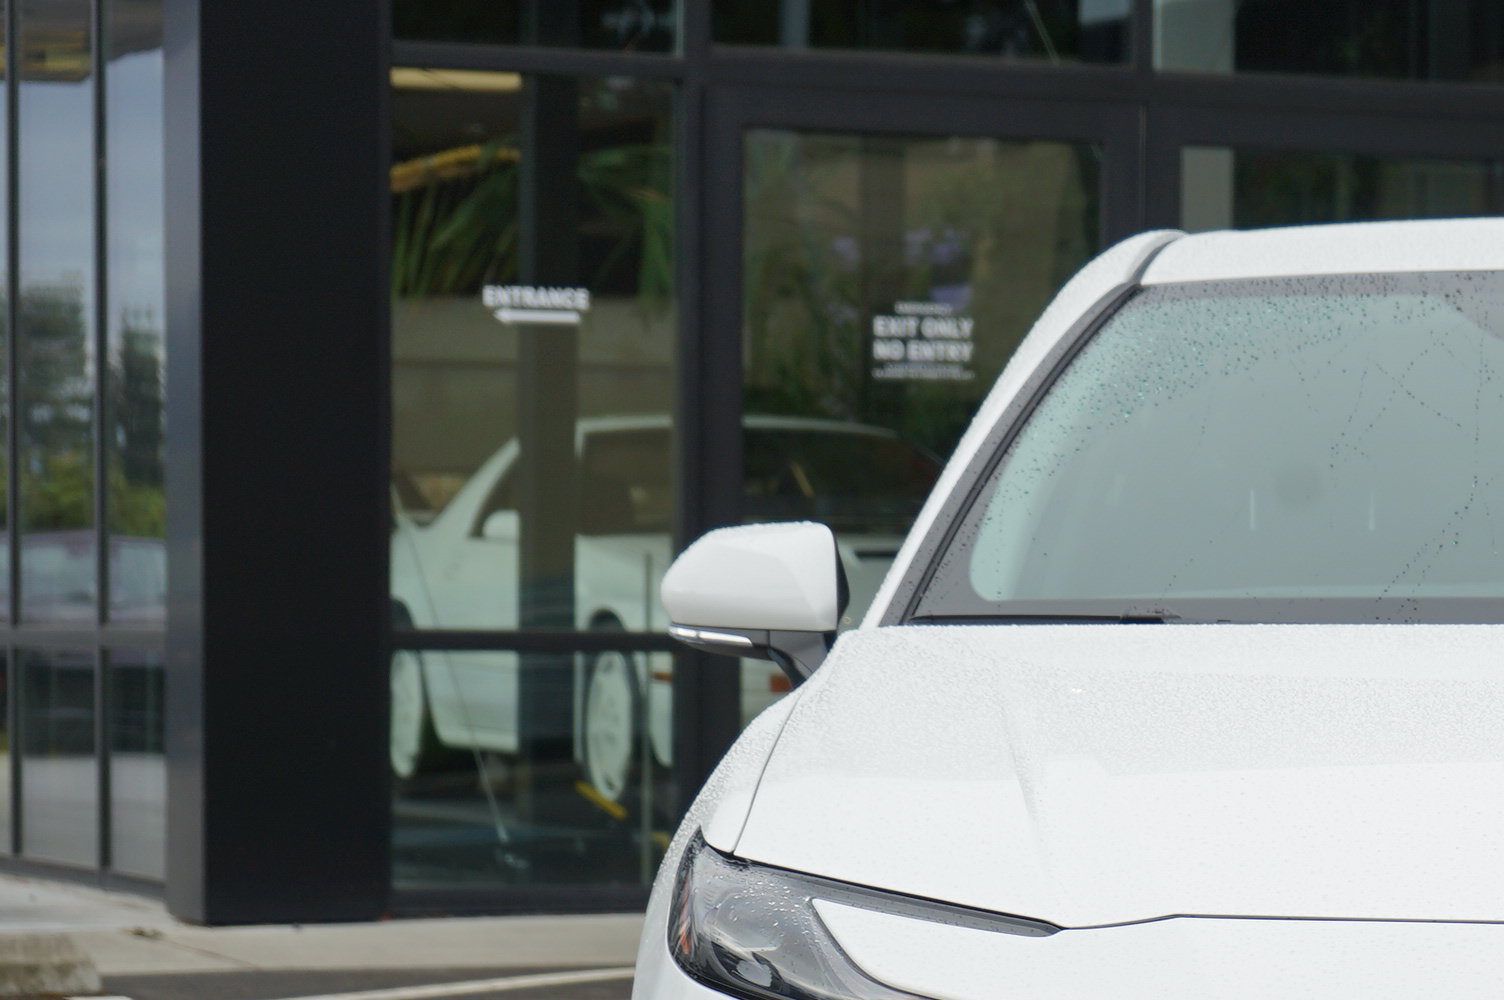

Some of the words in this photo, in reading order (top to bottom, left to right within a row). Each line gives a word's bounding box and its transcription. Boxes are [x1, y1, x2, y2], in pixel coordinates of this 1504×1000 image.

[483, 285, 590, 309] ENTRANCE
[873, 315, 919, 337] EXIT
[921, 316, 975, 338] ONLY
[873, 339, 905, 360] NO
[907, 340, 975, 361] ENTRY
